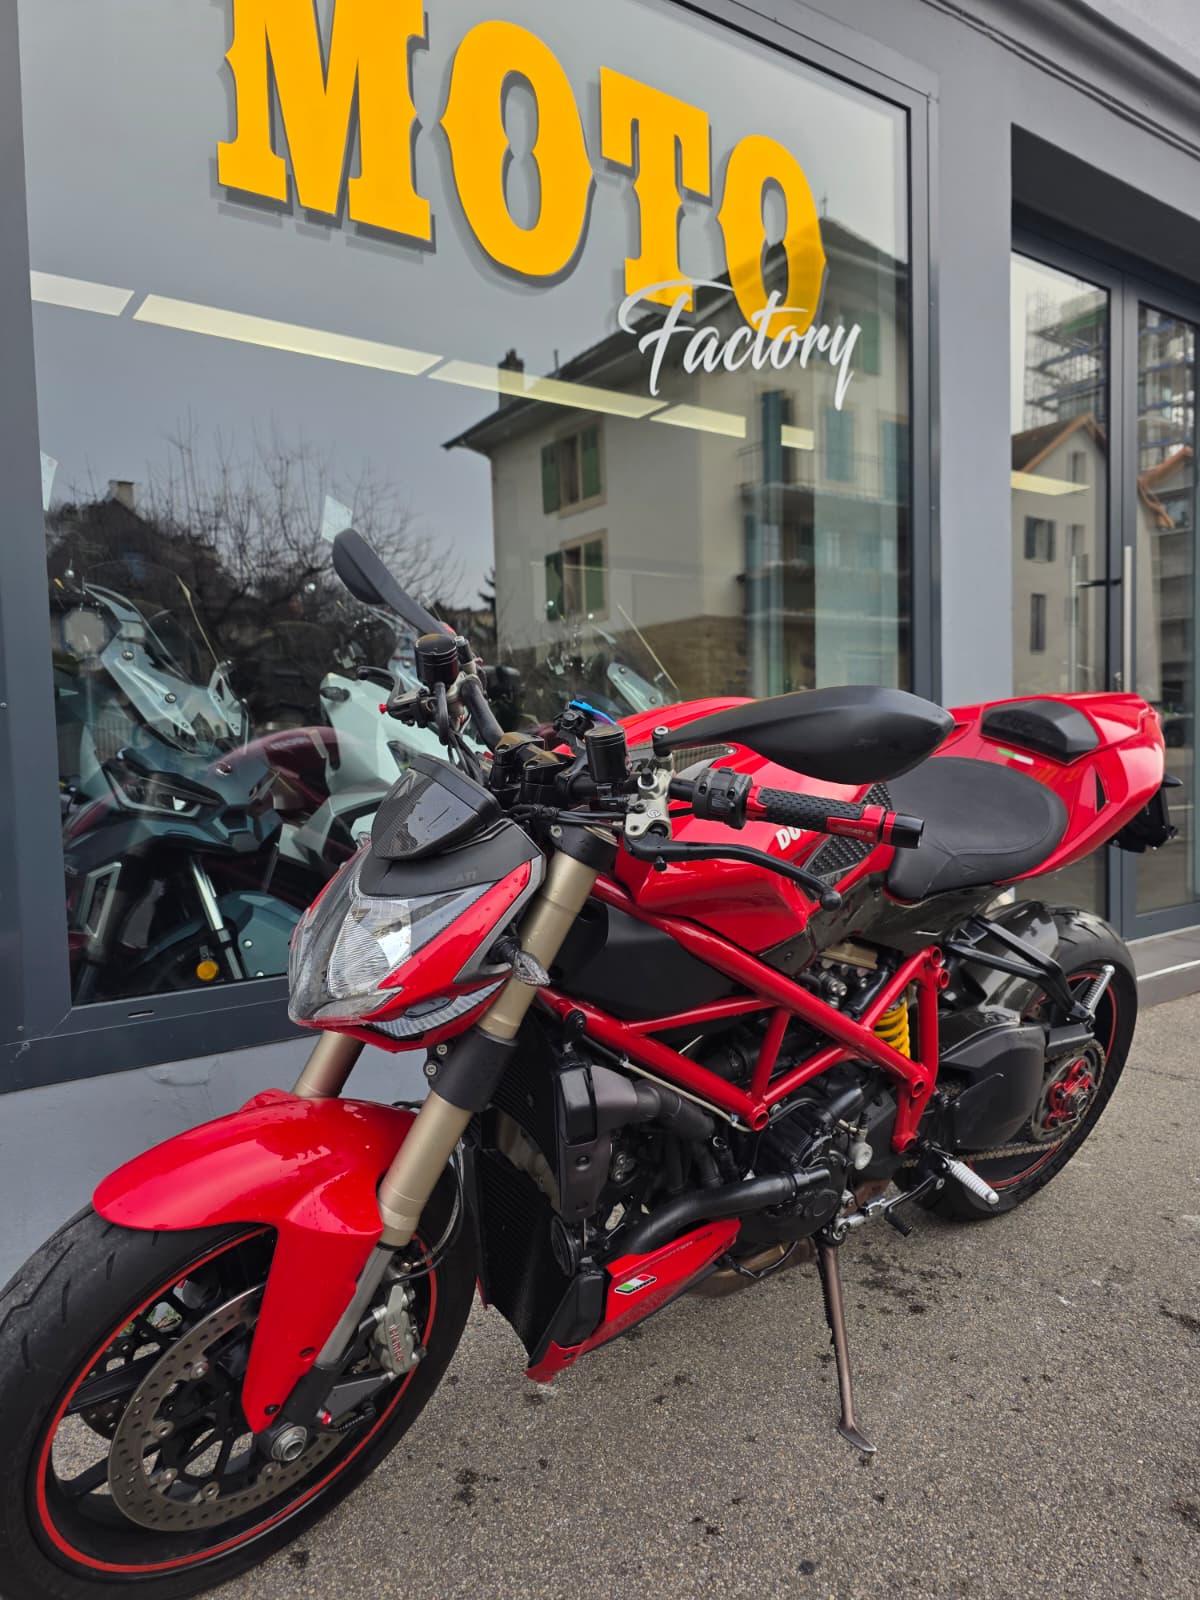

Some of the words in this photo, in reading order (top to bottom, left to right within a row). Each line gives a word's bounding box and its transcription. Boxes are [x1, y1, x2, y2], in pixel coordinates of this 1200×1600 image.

[217, 0, 826, 342] MOTO
[618, 279, 861, 411] Factory
[775, 826, 808, 851] DU
